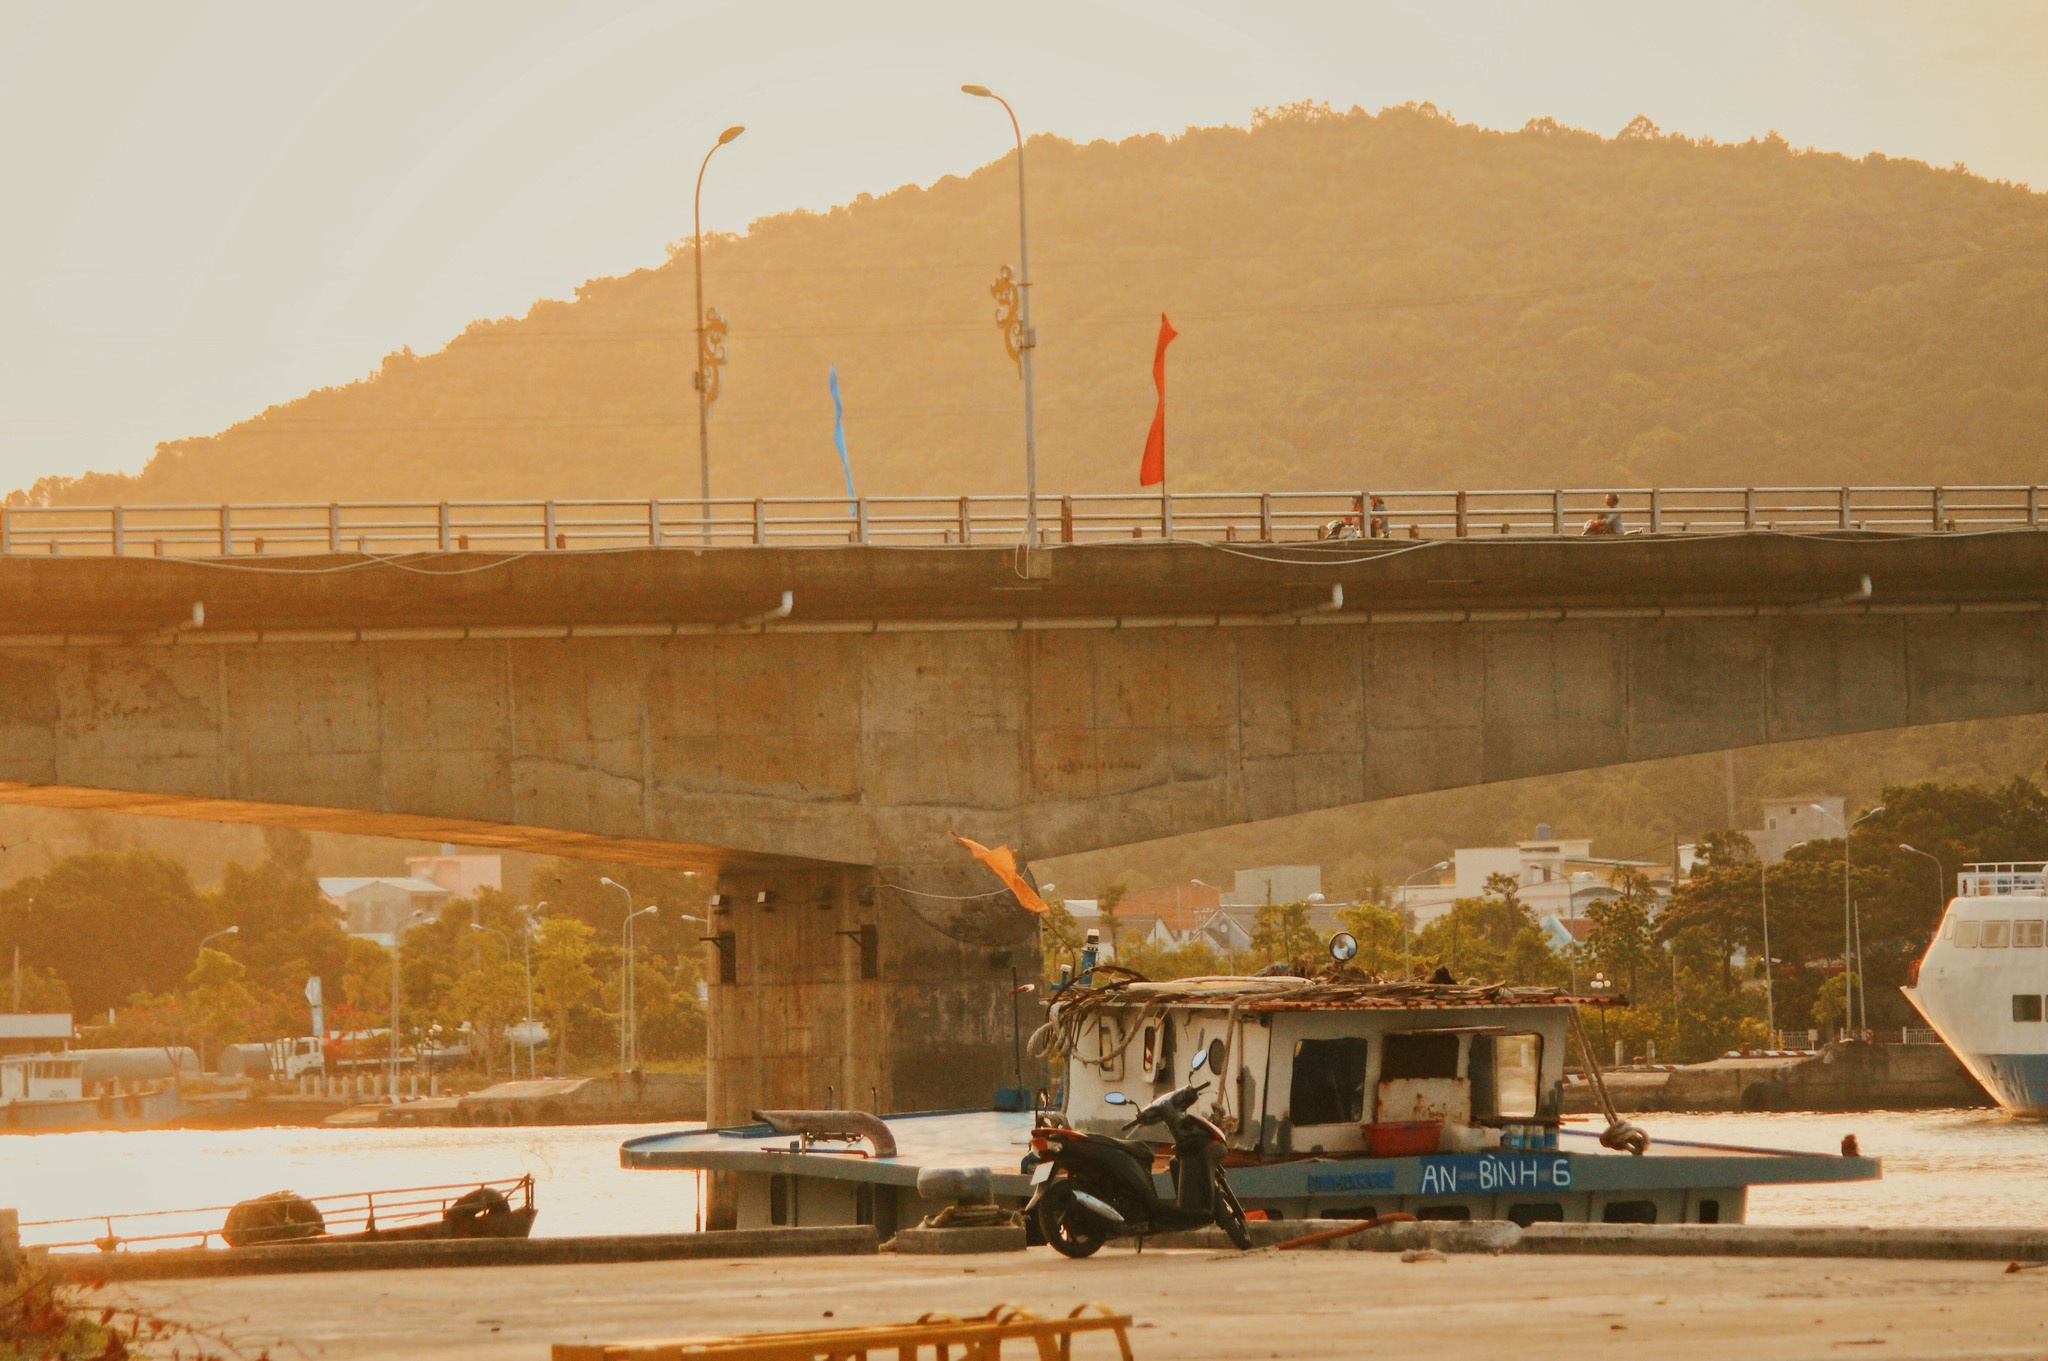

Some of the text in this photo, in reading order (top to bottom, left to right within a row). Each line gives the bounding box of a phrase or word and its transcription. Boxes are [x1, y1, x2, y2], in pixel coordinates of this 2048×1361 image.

[1421, 1165, 1457, 1194] AN
[1479, 1154, 1537, 1189] BÌNH
[1552, 1158, 1571, 1186] 6
